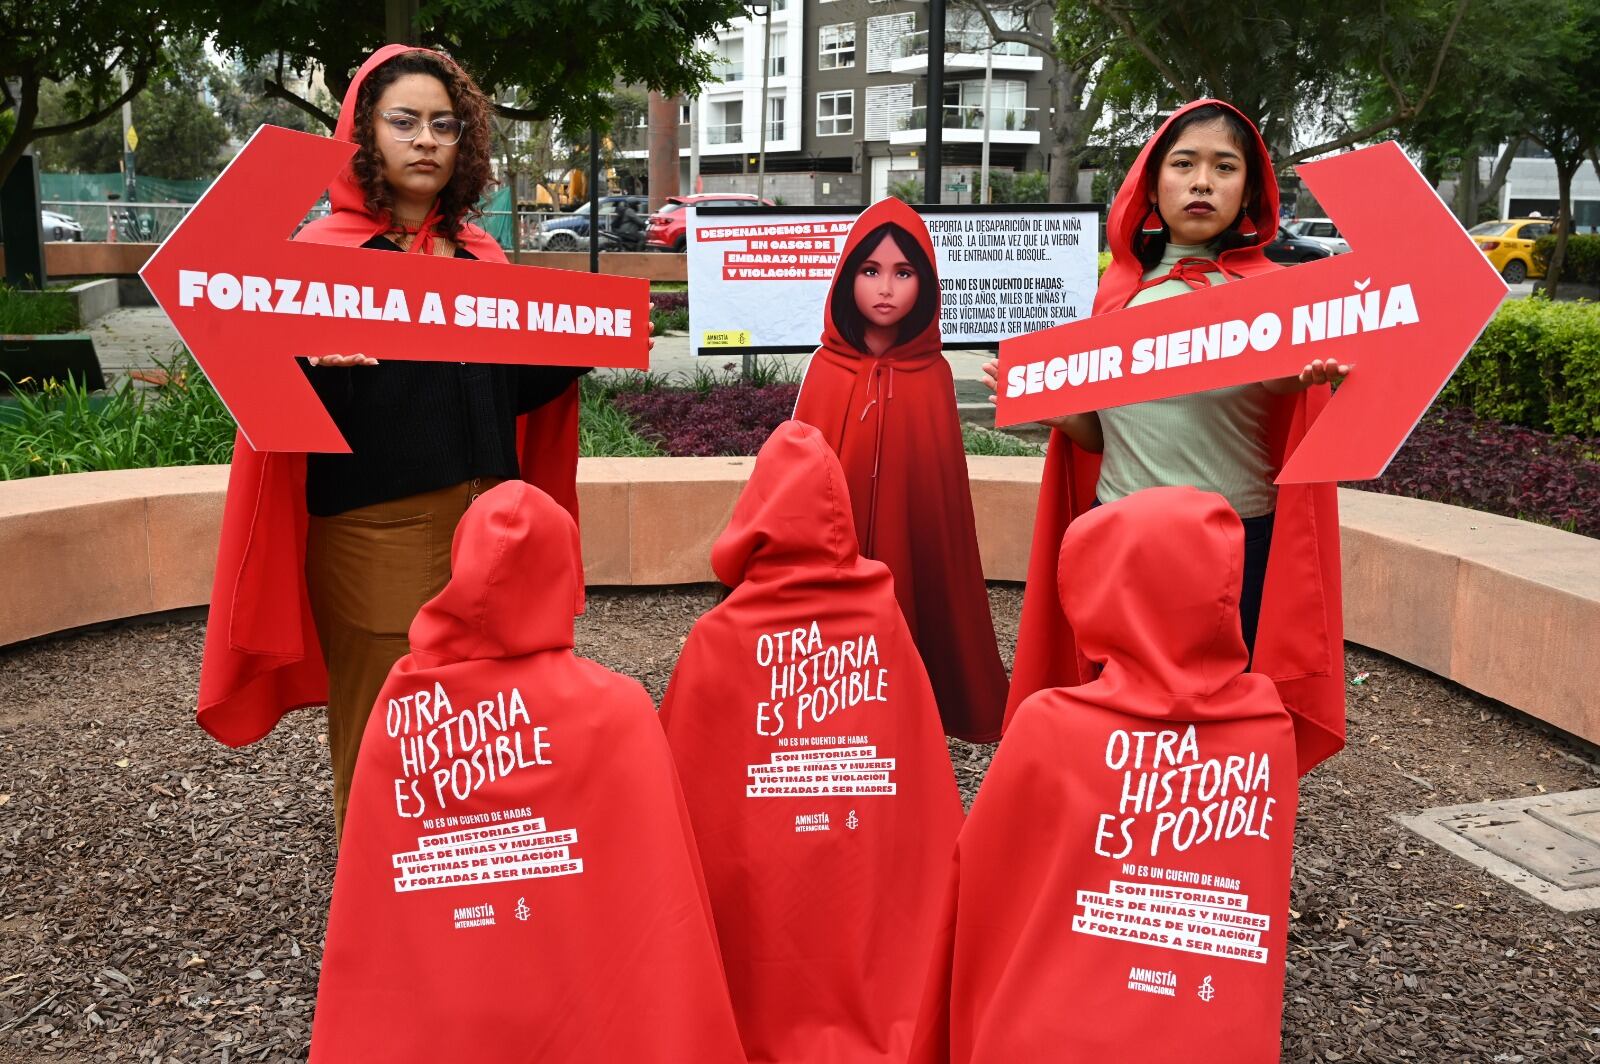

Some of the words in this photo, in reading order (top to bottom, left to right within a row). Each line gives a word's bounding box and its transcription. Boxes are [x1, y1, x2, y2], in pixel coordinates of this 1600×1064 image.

[814, 223, 828, 233] EL
[929, 220, 962, 232] REPORTA
[965, 220, 974, 232] LA
[976, 218, 1031, 232] DESAPARICIÓN
[1033, 220, 1042, 232] DE
[1044, 219, 1061, 231] UNA
[1063, 216, 1082, 231] NIÑA
[751, 241, 768, 250] EN
[815, 240, 830, 249] DE
[941, 233, 964, 247] AÑOS.
[967, 235, 976, 247] LA
[978, 232, 1005, 246] ÚLTIMA
[1008, 234, 1021, 246] VEZ
[1023, 234, 1038, 247] QUE
[1040, 234, 1050, 246] LA
[1051, 234, 1079, 246] VIERON
[728, 254, 797, 264] EMBARAZO
[948, 250, 962, 262] FUE
[964, 249, 1003, 262] ENTRANDO
[1005, 249, 1014, 261] AL
[727, 269, 736, 278] Y
[739, 266, 806, 277] VIOLACIÓN
[808, 269, 834, 277] SEX
[939, 278, 953, 291] STO
[955, 278, 967, 291] NO
[968, 278, 978, 290] ES
[979, 278, 991, 290] UN
[992, 278, 1022, 290] CUENTO
[1023, 278, 1034, 290] DE
[1035, 277, 1064, 289] HADAS:
[178, 269, 411, 322] FORZARLA
[418, 292, 447, 325] A
[453, 294, 520, 330] SER
[527, 302, 632, 337] MADRE
[942, 294, 957, 305] DOS
[959, 293, 973, 305] LOS
[1000, 292, 1023, 305] MILES
[1024, 292, 1034, 304] DE
[1036, 290, 1060, 304] NIÑAS
[1061, 292, 1067, 303] Y
[959, 306, 995, 320] VÍCTIMAS
[997, 307, 1007, 319] DE
[1008, 304, 1048, 319] VIOLACIÓN
[1050, 306, 1077, 318] SEXUAL
[942, 323, 958, 335] SON
[960, 322, 998, 334] FORZADAS
[1000, 322, 1006, 334] A
[1007, 321, 1022, 333] SER
[1006, 345, 1123, 398] SEGUIR
[1130, 312, 1282, 375] SIENDO
[756, 620, 823, 666] OTRA
[770, 634, 879, 700] HISTORIA
[386, 681, 453, 738] OTRA
[756, 702, 784, 736] ES
[797, 668, 888, 730] POSIBLE
[400, 687, 531, 778] HISTORIA
[779, 738, 788, 747] NO
[790, 738, 798, 746] ES
[800, 737, 810, 746] UN
[811, 736, 836, 746] CUENTO
[837, 736, 846, 745] DE
[847, 735, 868, 745] HADAS
[775, 753, 799, 762] SON
[801, 750, 858, 761] HISTORIAS
[860, 749, 872, 757] DE
[1105, 724, 1199, 770] OTRA
[394, 778, 426, 818] ES
[433, 726, 553, 809] POSIBLE
[751, 765, 784, 774] MILES
[850, 761, 892, 770] MUJERES
[815, 774, 828, 782] DE
[831, 771, 886, 782] VIOLACIÓN
[761, 786, 820, 794] FORZADAS
[832, 785, 854, 793] SER
[855, 785, 893, 793] MADRES
[1119, 751, 1269, 814] HISTORIA
[423, 819, 436, 830] NO
[436, 817, 446, 828] ES
[447, 816, 458, 827] UN
[460, 813, 490, 826] CUENTO
[491, 811, 502, 822] DE
[503, 807, 532, 820] HADAS
[795, 812, 829, 826] AMNISTÍA
[795, 824, 830, 832] INTERNACIONAL
[1095, 813, 1135, 859] ES
[1150, 795, 1276, 856] POSIBLE
[422, 836, 448, 847] SON
[451, 825, 520, 844] HISTORIAS
[523, 822, 540, 832] DE
[396, 851, 435, 865] MILES
[437, 848, 453, 859] DE
[499, 842, 509, 851] Y
[511, 833, 572, 849] MUJERES
[472, 858, 488, 868] DE
[491, 849, 564, 865] VIOLACIÓN
[398, 880, 407, 889] Y
[410, 872, 479, 887] FORZADAS
[481, 871, 491, 880] A
[493, 868, 519, 879] SER
[522, 862, 578, 876] MADRES
[1122, 863, 1136, 875] NO
[1137, 866, 1149, 877] ES
[1150, 867, 1163, 879] UN
[1166, 869, 1200, 883] CUENTO
[1201, 874, 1212, 886] DE
[1214, 875, 1241, 890] HADAS
[1114, 884, 1146, 896] SON
[1150, 888, 1225, 905] HISTORIAS
[1227, 897, 1243, 907] DE
[453, 903, 494, 920] AMNISTÍA
[1081, 894, 1124, 909] MILES
[1128, 900, 1147, 911] DE
[1199, 910, 1209, 919] Y
[1212, 912, 1266, 928] MUJERES
[454, 918, 496, 929] INTERNACIONAL
[1164, 920, 1184, 931] DE
[1187, 923, 1255, 942] VIOLACIÓN
[1077, 920, 1087, 929] Y
[1089, 921, 1169, 944] FORZADAS
[1172, 937, 1182, 947] A
[1186, 938, 1212, 951] SER
[1216, 944, 1263, 960] MADRES
[1129, 967, 1177, 987] AMNISTÍA
[1128, 981, 1175, 997] INTERNACIONAL
